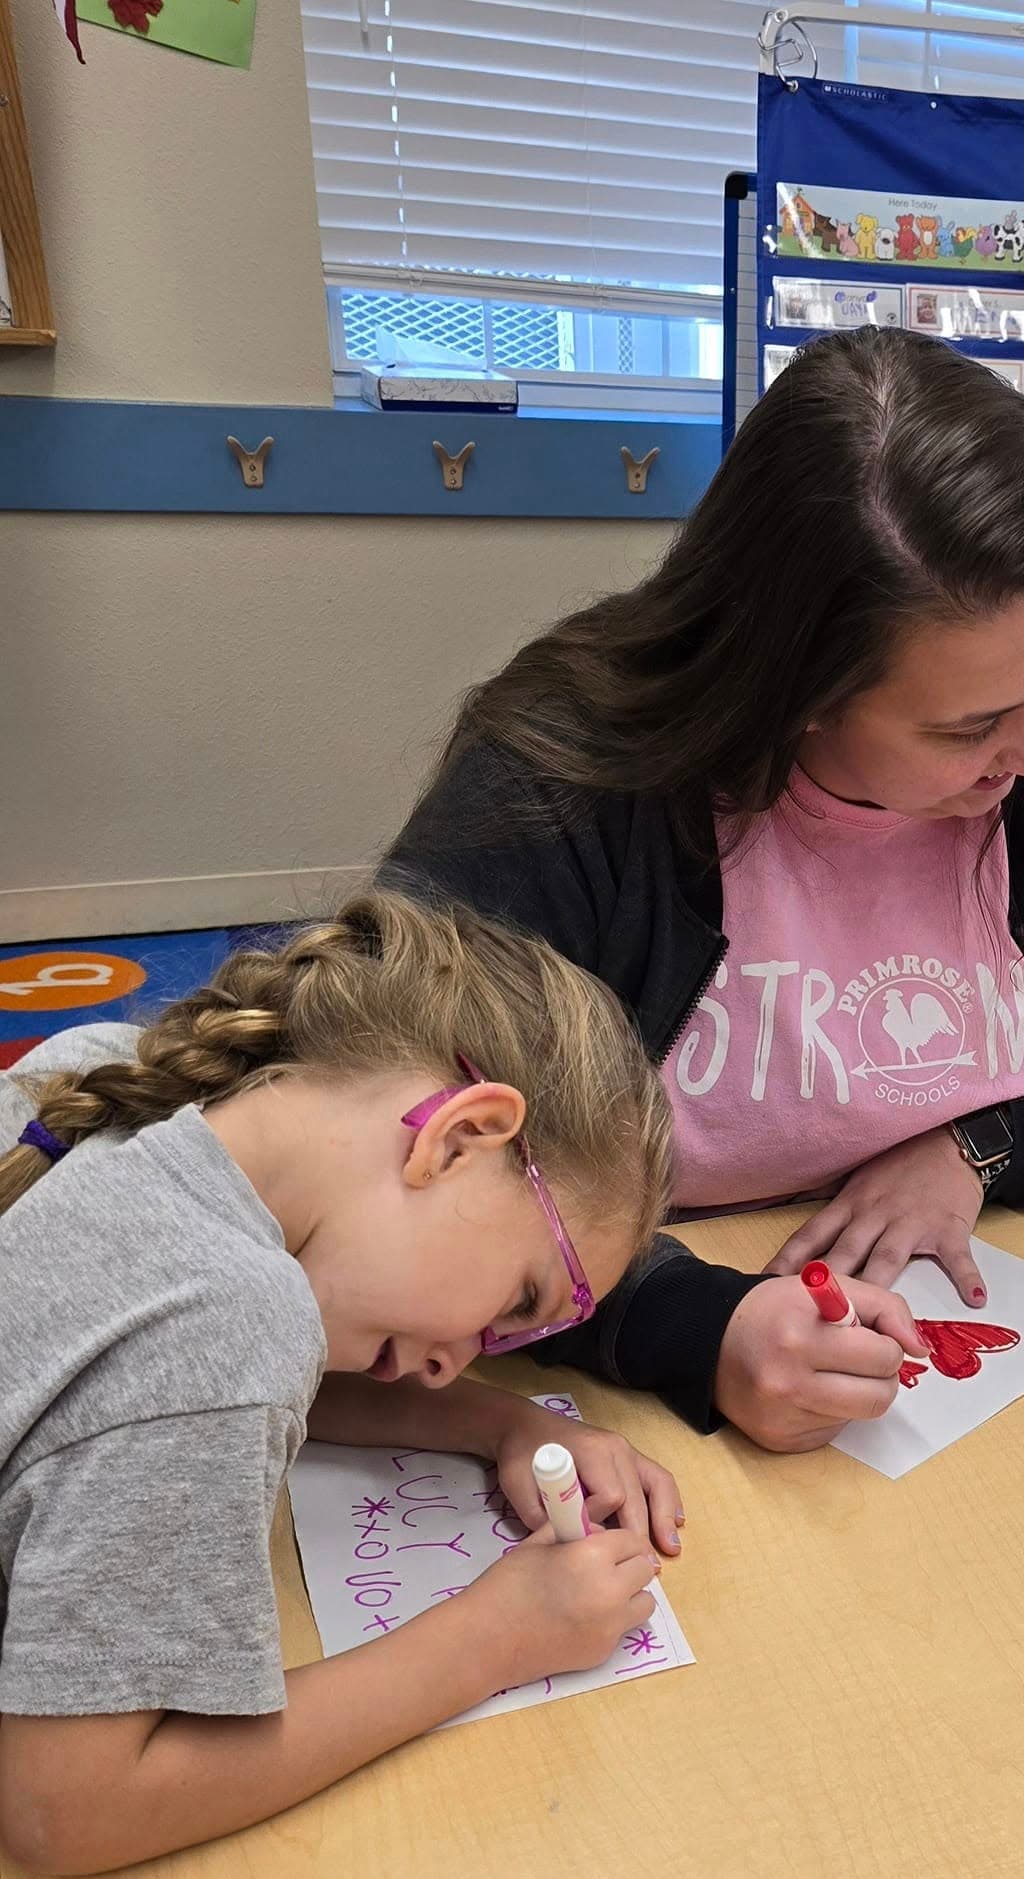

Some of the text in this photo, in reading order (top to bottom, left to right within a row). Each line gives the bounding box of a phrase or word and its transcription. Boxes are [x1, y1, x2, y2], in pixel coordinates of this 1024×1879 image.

[888, 197, 938, 211] Here Today
[874, 1075, 961, 1106] SCHOOLS
[391, 1449, 471, 1559] LUCY
